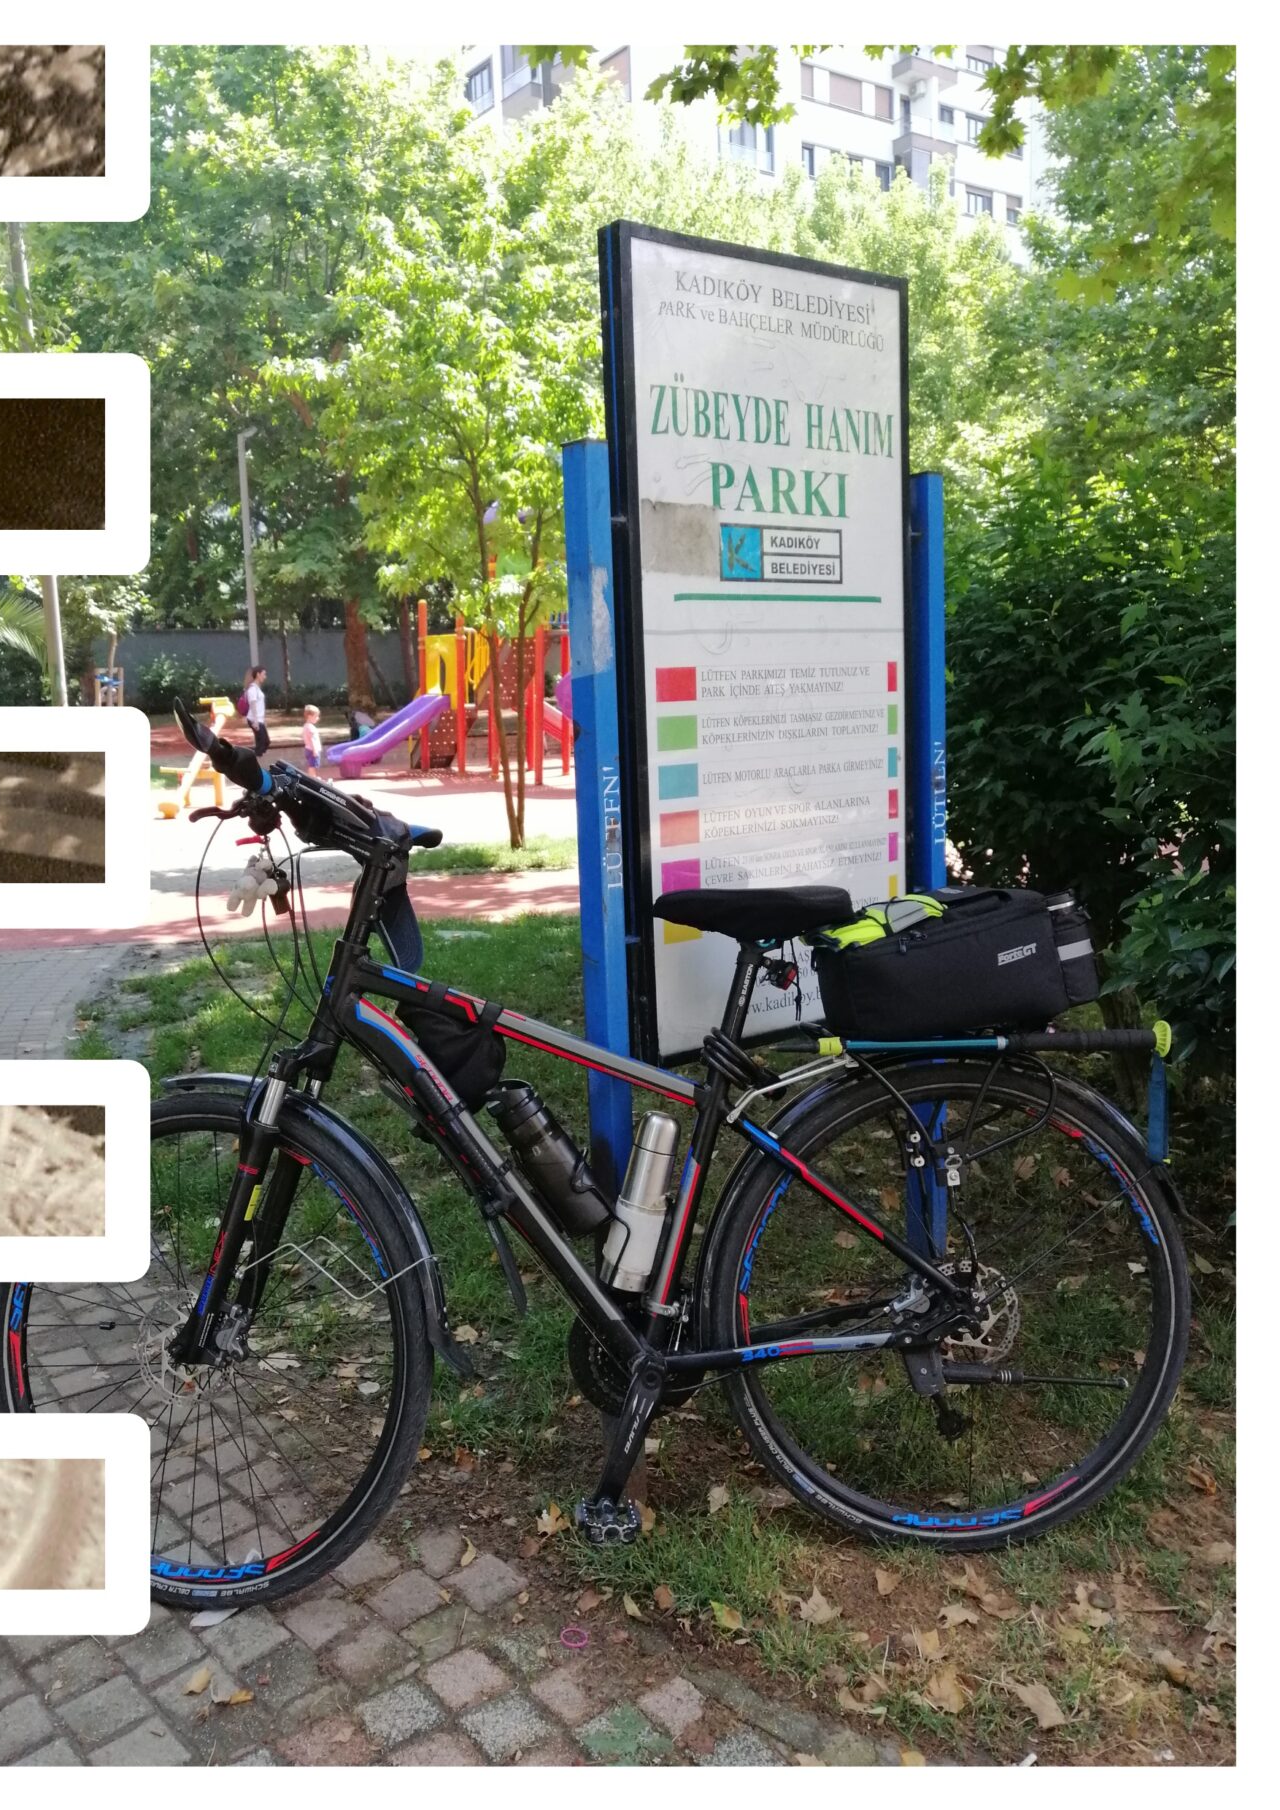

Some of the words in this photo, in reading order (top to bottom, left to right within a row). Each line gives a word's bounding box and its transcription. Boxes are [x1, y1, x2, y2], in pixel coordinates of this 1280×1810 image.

[675, 271, 762, 303] KADIKÖY
[772, 288, 871, 325] BELEDİYESİ
[658, 301, 697, 320] PARK
[700, 310, 715, 322] ve
[720, 309, 795, 335] BAHÇELER
[801, 321, 885, 352] MÜDÜRLÜĞÜ
[649, 372, 791, 447] ZÜBEYDE
[804, 402, 894, 459] HANIM
[707, 461, 850, 518] PARKI
[770, 535, 821, 550] KADIKÖY
[771, 560, 836, 576] BELEDİYESİ
[701, 668, 737, 682] LÜTFEN
[741, 668, 786, 681] PARKIMIZI
[790, 667, 816, 679] TEMİZ
[820, 667, 858, 678] TUTUNUZ
[859, 666, 870, 677] VE
[701, 686, 725, 698] PARK
[730, 684, 761, 697] İÇİNDE
[764, 683, 786, 697] ATEŞ
[789, 681, 844, 694] YAKMAYINIZ!
[702, 716, 731, 729] LÜTFEN
[702, 730, 775, 745] KÖPEKLERİNİZİN
[832, 723, 879, 736] TOPLAYINIZ!
[702, 770, 732, 785] LÜTFEN
[734, 767, 771, 782] MOTORLU
[819, 762, 841, 774] PARKA
[703, 809, 741, 824] LÜTFEN
[744, 806, 772, 819] OYUN
[774, 804, 786, 815] VE
[780, 815, 840, 831] SOKMAYINIZ!
[705, 855, 740, 870] LÜTFEN
[705, 872, 734, 887] ÇEVRE
[741, 963, 754, 995] EASTON
[741, 1346, 781, 1362] 340
